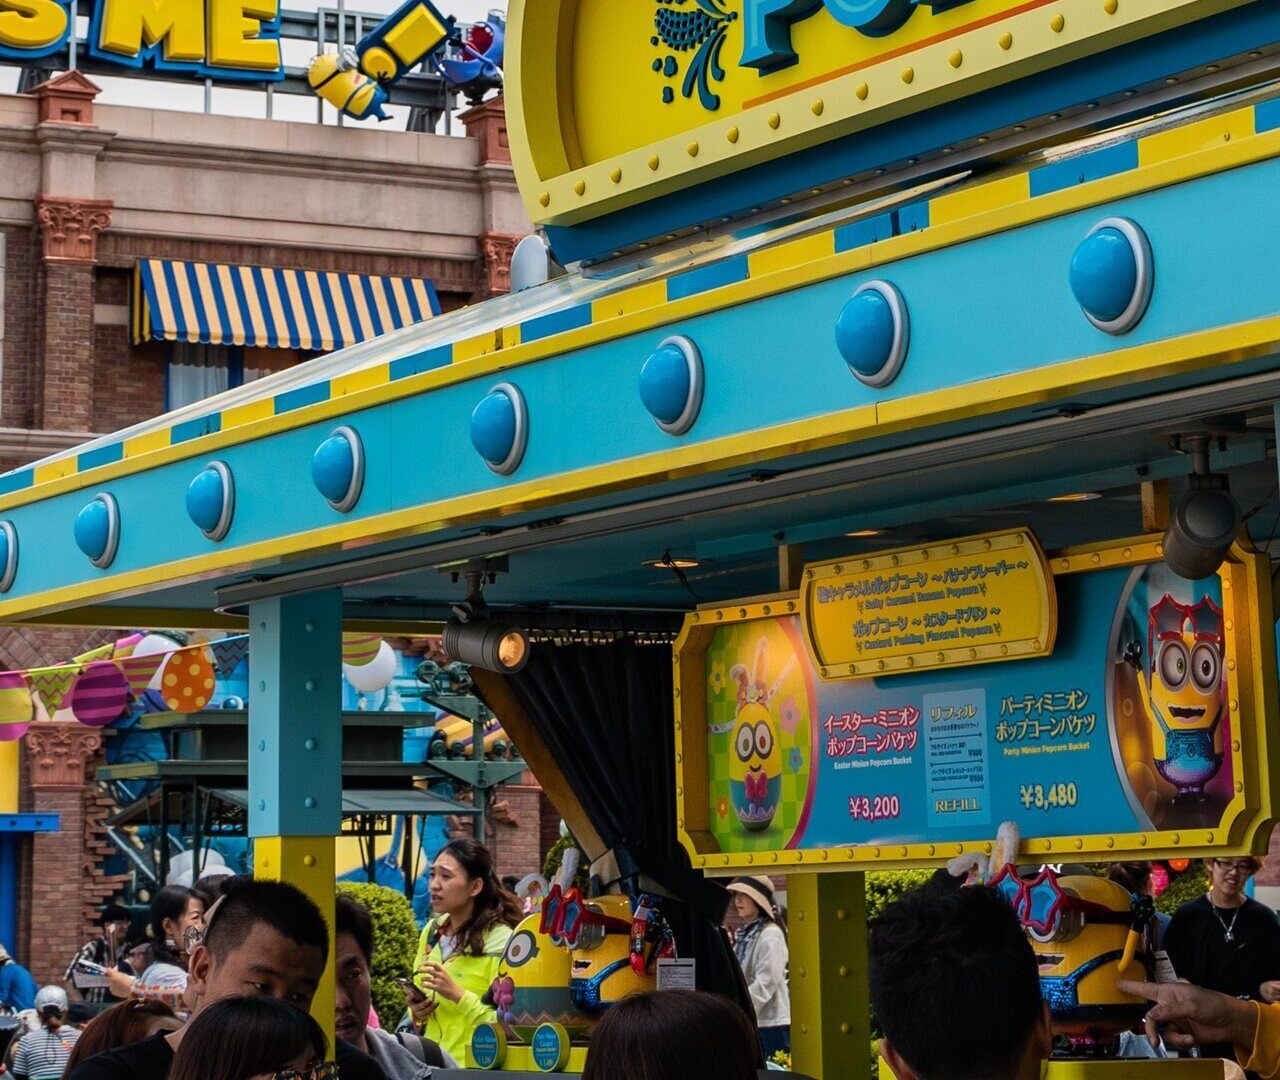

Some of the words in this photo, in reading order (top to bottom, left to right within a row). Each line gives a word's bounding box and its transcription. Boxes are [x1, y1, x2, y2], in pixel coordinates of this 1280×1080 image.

[946, 585, 979, 598] Popcorn
[961, 624, 994, 638] Popcorn
[930, 703, 978, 723] リフィル
[1042, 743, 1068, 754] Popcorn
[870, 757, 893, 769] Popcorn
[893, 755, 912, 766] Bucket
[1020, 782, 1078, 812] ¥3,480
[848, 794, 900, 823] ¥3,200
[935, 797, 983, 814] REFILL
